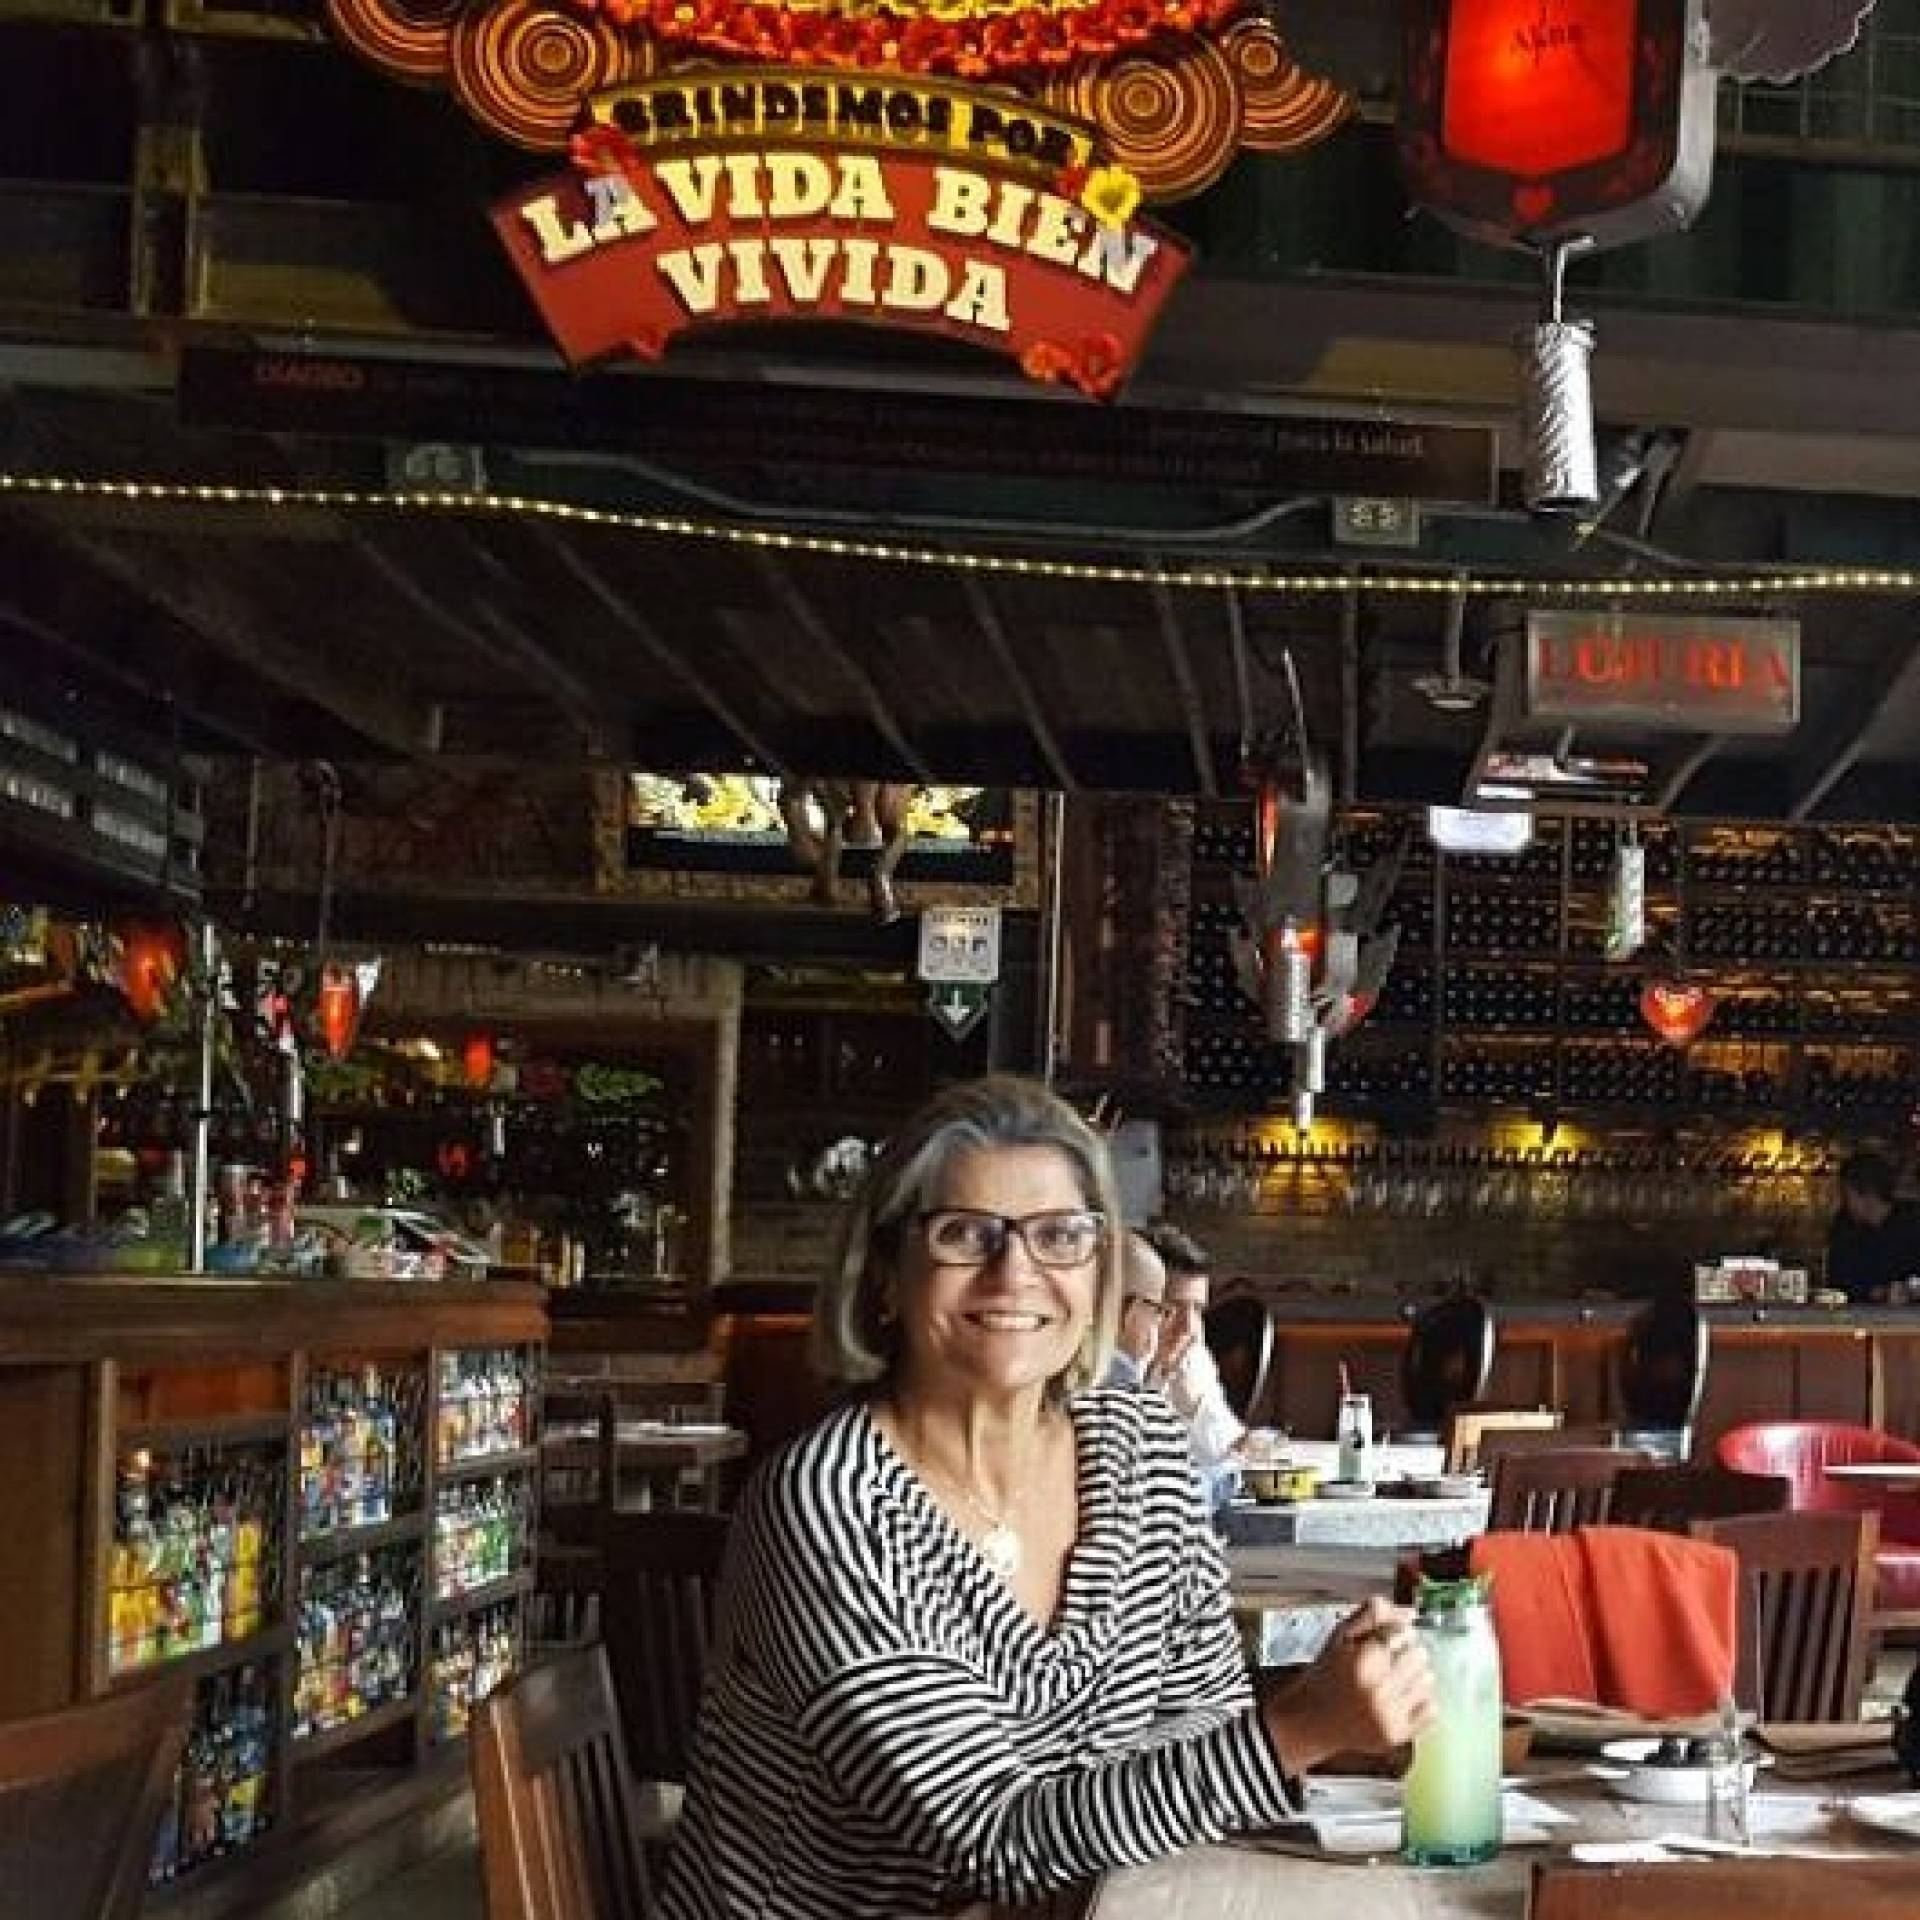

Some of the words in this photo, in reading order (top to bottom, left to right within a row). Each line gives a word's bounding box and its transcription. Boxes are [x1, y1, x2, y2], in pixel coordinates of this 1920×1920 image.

[522, 175, 658, 264] LA
[656, 153, 896, 223] VIDA
[926, 167, 1158, 293] BIEN
[656, 238, 1011, 331] VIVIDA
